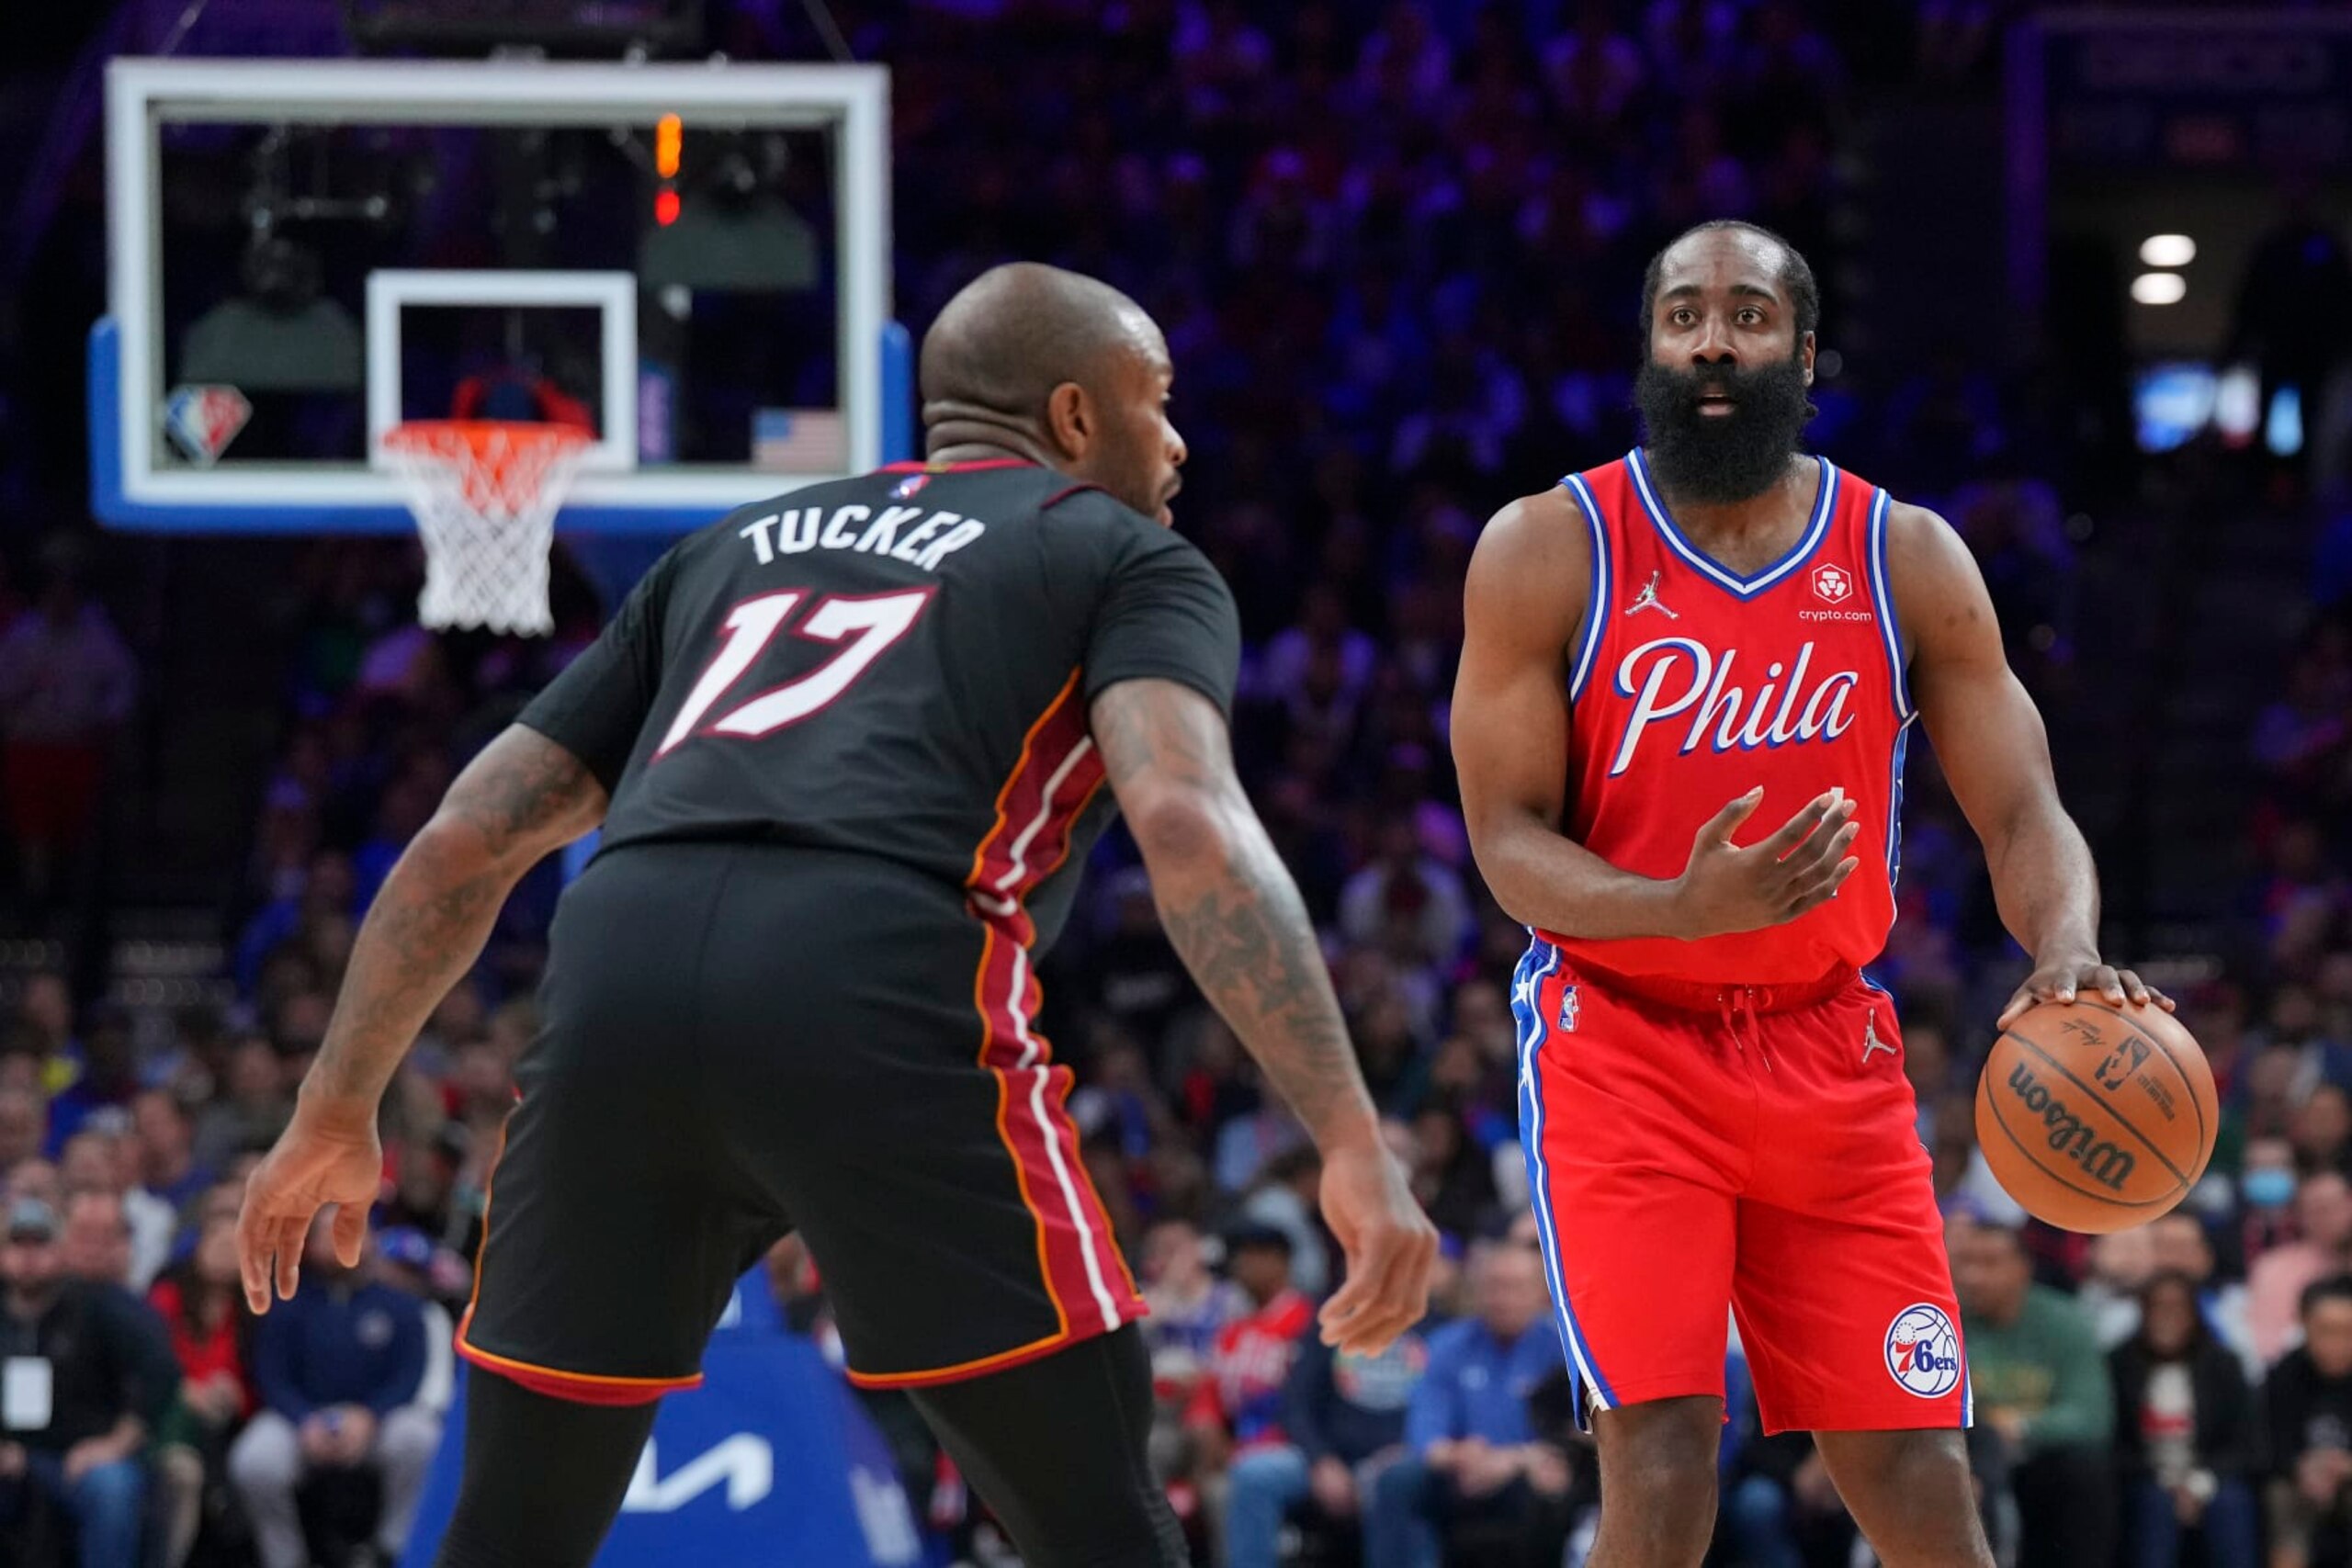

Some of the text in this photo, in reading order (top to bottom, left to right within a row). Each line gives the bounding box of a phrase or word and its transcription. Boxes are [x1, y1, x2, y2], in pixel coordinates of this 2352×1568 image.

[739, 504, 986, 572] TUCKER
[1798, 608, 1872, 623] crypto.com
[649, 585, 940, 766] 17
[1608, 637, 1860, 778] Phila
[2007, 1062, 2137, 1190] Wilson
[1894, 1339, 1957, 1373] 76ers
